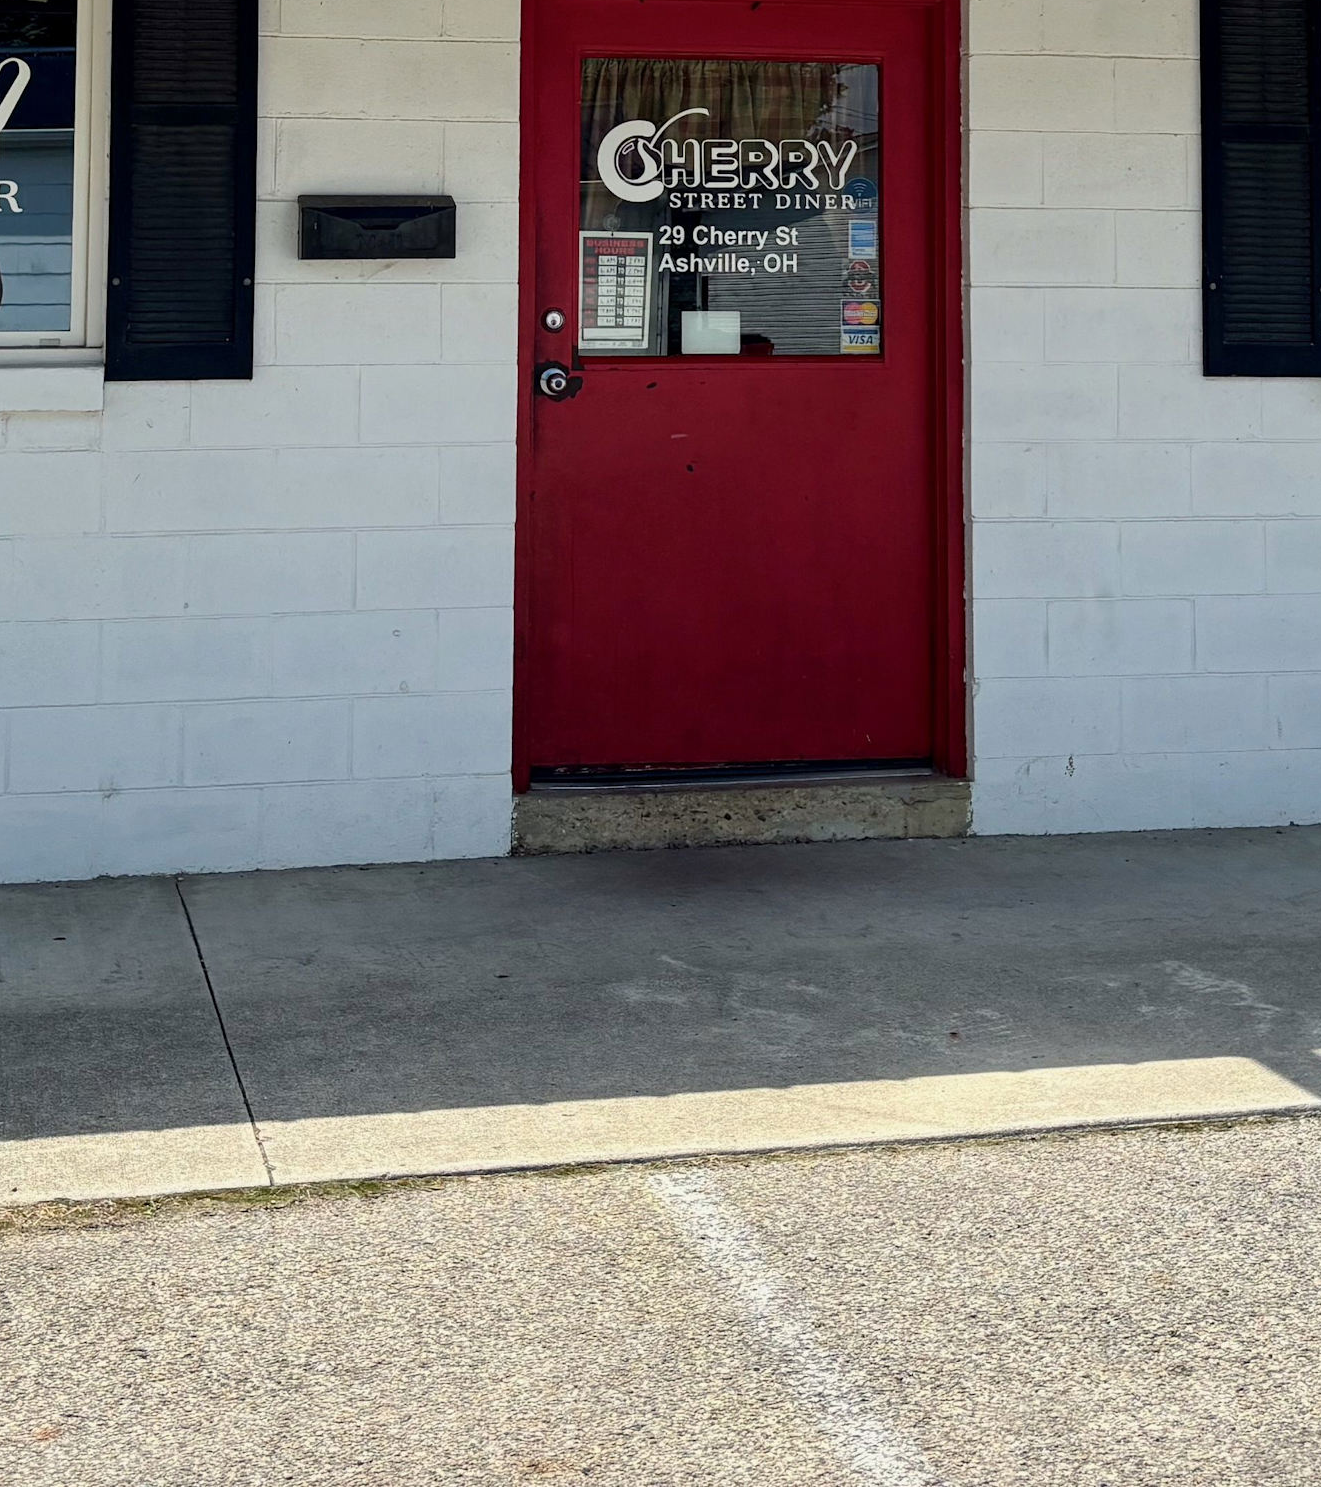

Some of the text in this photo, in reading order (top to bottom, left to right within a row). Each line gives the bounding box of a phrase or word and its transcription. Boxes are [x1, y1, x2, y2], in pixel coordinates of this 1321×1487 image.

[597, 119, 858, 202] CHERRY
[669, 193, 856, 210] STREET DINER
[586, 239, 644, 248] BUSINESS
[658, 226, 798, 250] 29 Cherry St
[658, 253, 798, 275] Ashville, OH
[848, 335, 873, 345] VISA
